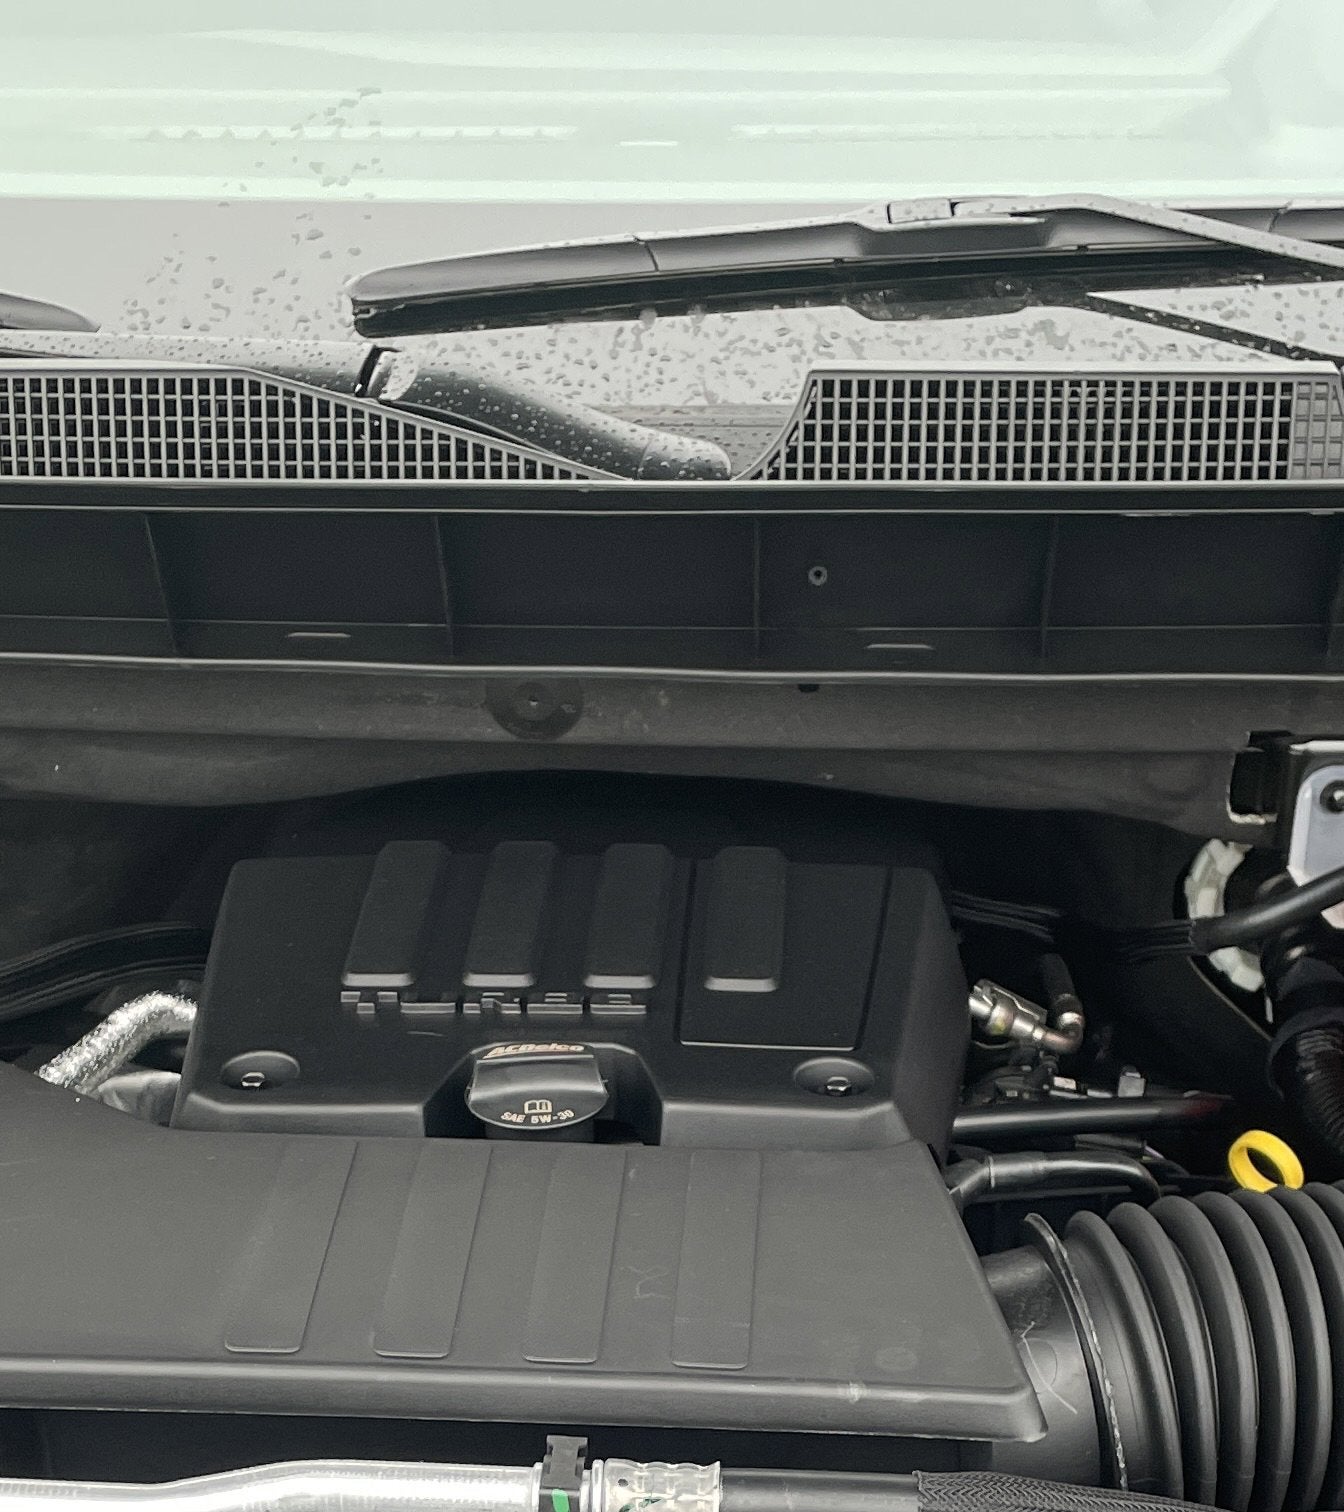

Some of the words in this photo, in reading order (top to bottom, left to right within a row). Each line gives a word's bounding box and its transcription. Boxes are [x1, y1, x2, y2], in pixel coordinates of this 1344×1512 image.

[483, 1042, 585, 1059] ACDelco
[500, 1111, 526, 1123] SAE
[530, 1109, 575, 1124] 5W-30
